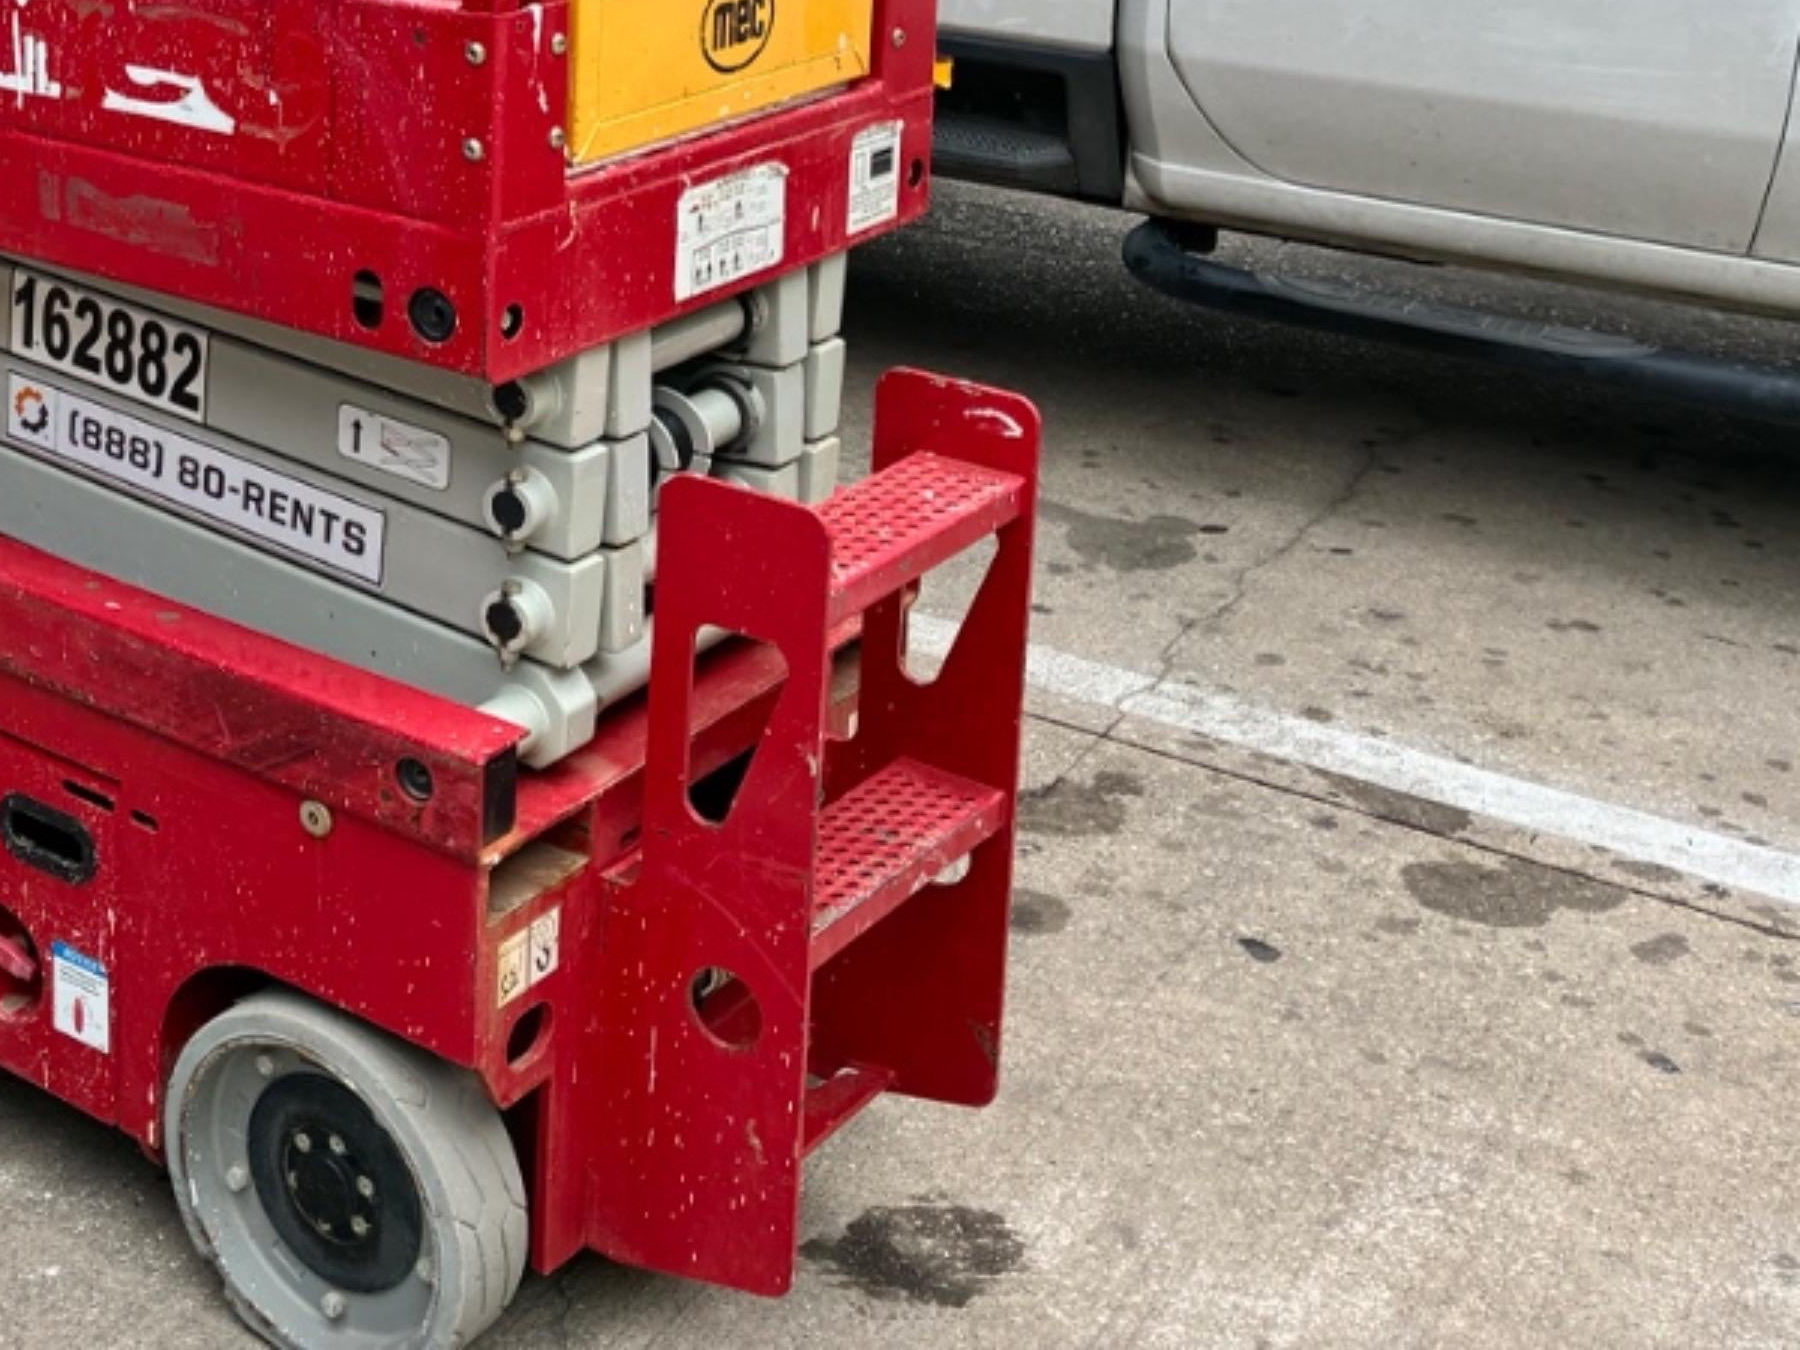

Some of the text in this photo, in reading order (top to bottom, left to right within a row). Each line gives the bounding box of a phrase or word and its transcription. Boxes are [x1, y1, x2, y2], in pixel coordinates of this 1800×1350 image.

[14, 275, 202, 413] 162882
[68, 409, 367, 556] (888) 80-RENTS
